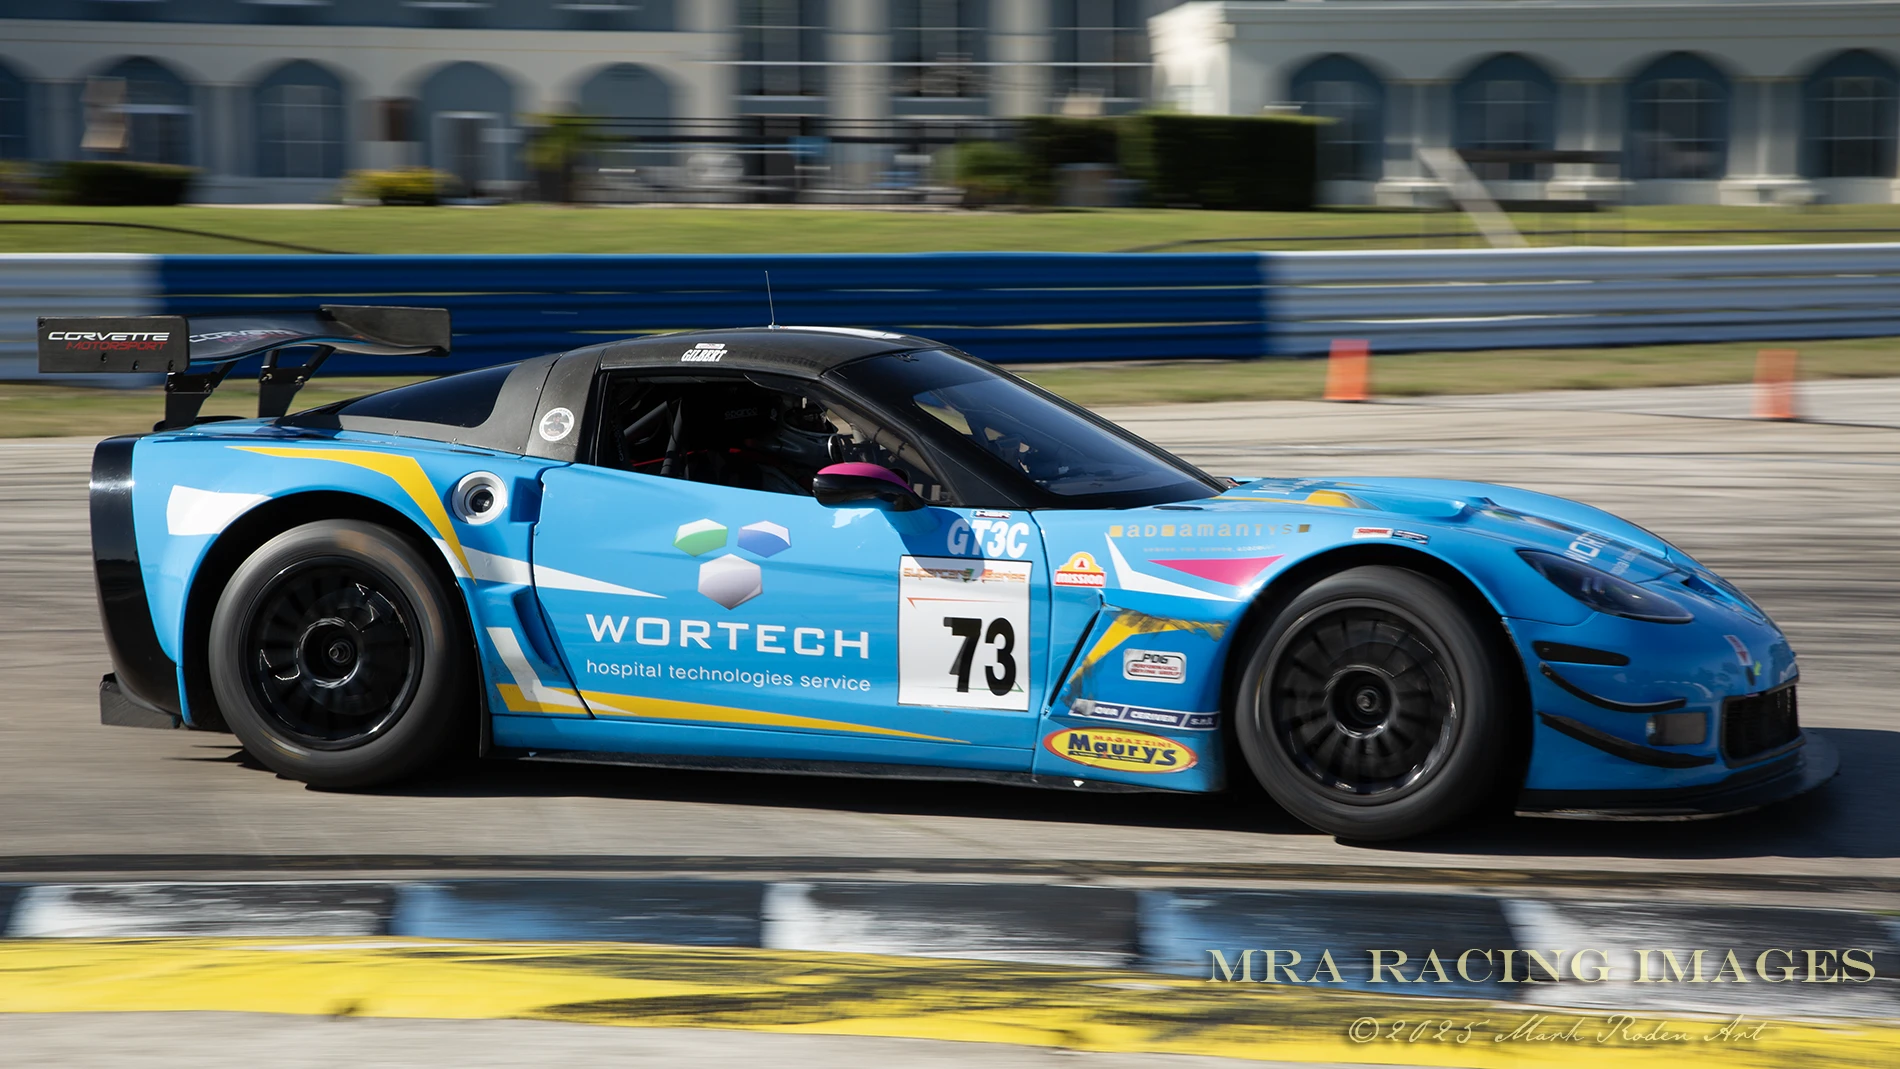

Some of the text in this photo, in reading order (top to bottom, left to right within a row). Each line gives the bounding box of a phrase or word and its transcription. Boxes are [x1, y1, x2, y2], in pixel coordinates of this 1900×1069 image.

[48, 331, 171, 341] CORVETTE
[65, 341, 169, 351] MOTORSPORT
[681, 349, 728, 362] GILBERT
[947, 518, 1029, 558] GT3C
[586, 614, 869, 659] WORTECH
[943, 617, 1017, 696] 73
[587, 660, 871, 691] hospital technologies service
[1092, 734, 1173, 749] MAGAZZINI
